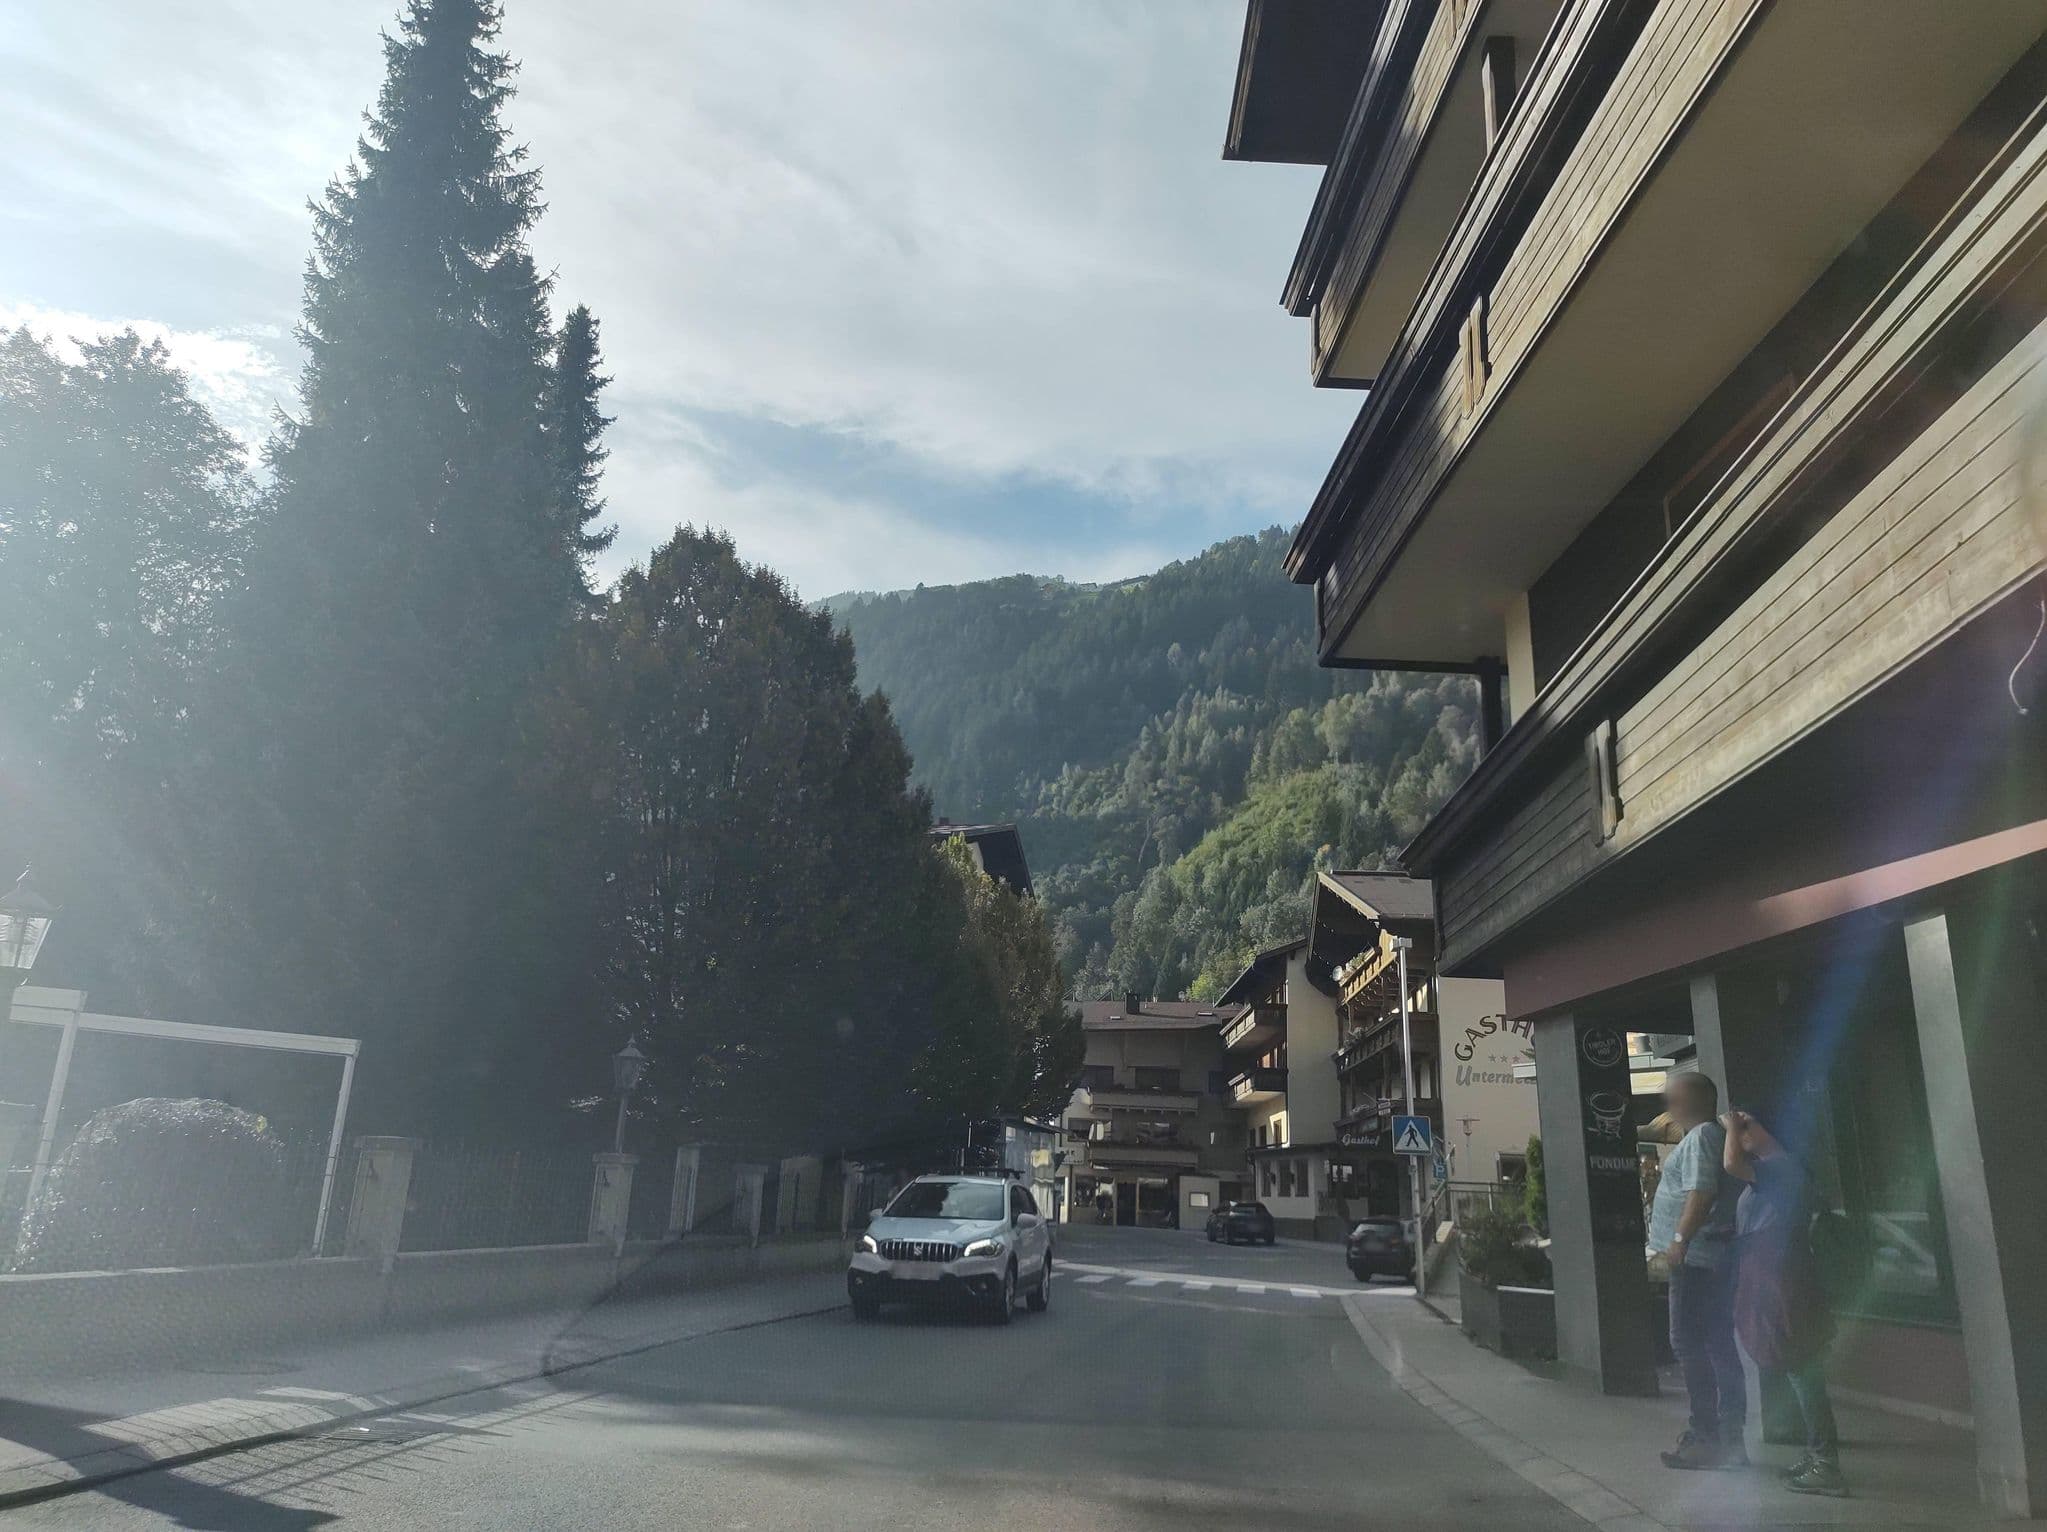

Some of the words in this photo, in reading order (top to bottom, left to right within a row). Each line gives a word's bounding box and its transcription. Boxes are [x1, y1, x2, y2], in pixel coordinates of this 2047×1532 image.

[1454, 1013, 1536, 1062] GASTH
[1342, 1133, 1380, 1147] Gasthof
[1589, 1155, 1637, 1169] FONDUE
